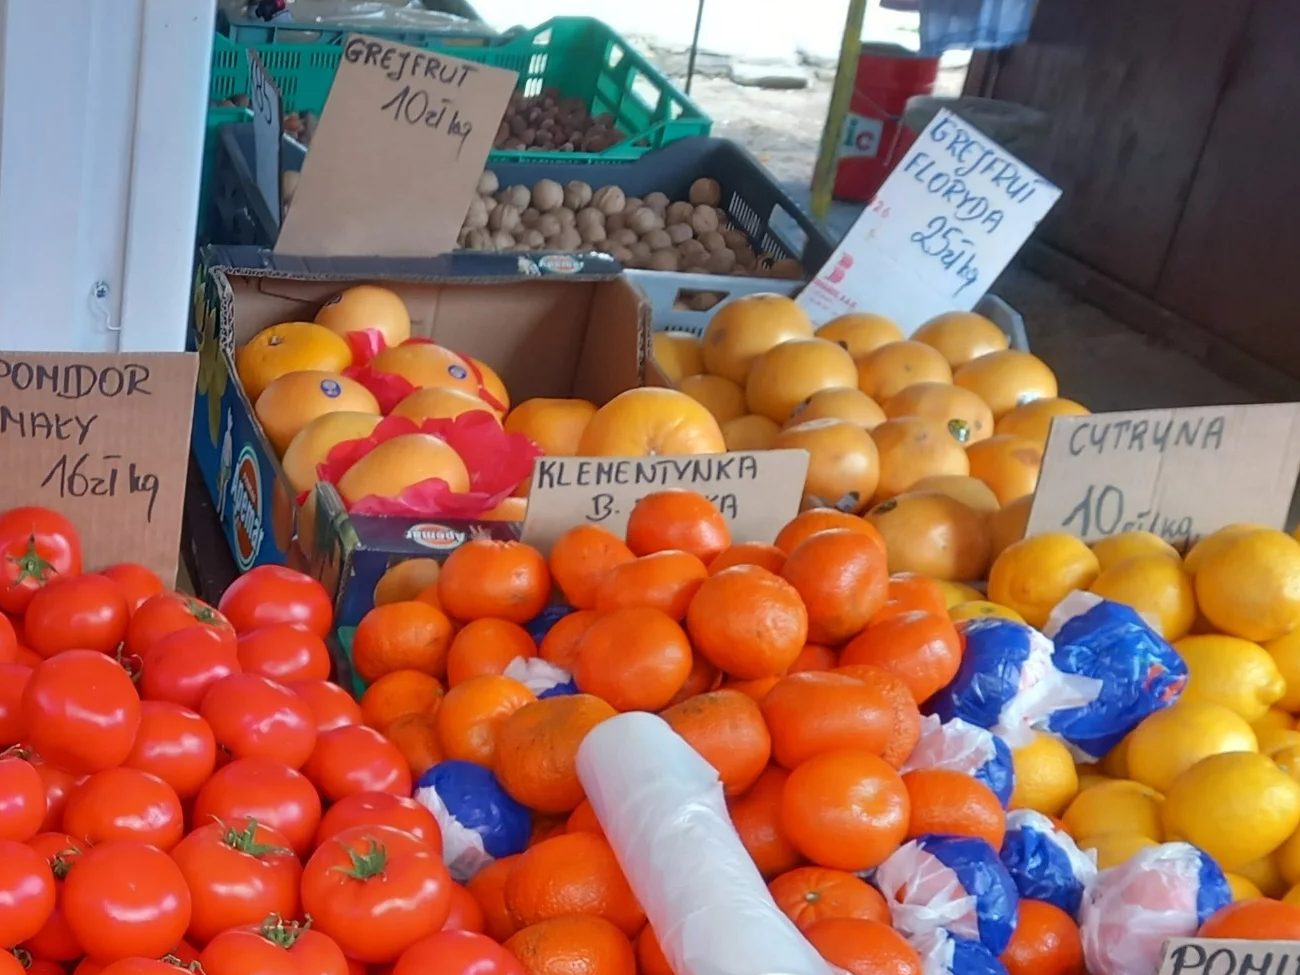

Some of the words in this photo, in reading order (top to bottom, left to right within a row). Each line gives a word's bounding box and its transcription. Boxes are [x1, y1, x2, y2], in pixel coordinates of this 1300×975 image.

[345, 38, 478, 88] GREJFRUT
[904, 152, 1004, 234] FLORYDA
[1069, 415, 1225, 457] CYTRYNA
[537, 455, 758, 489] KLEMENTYNKA
